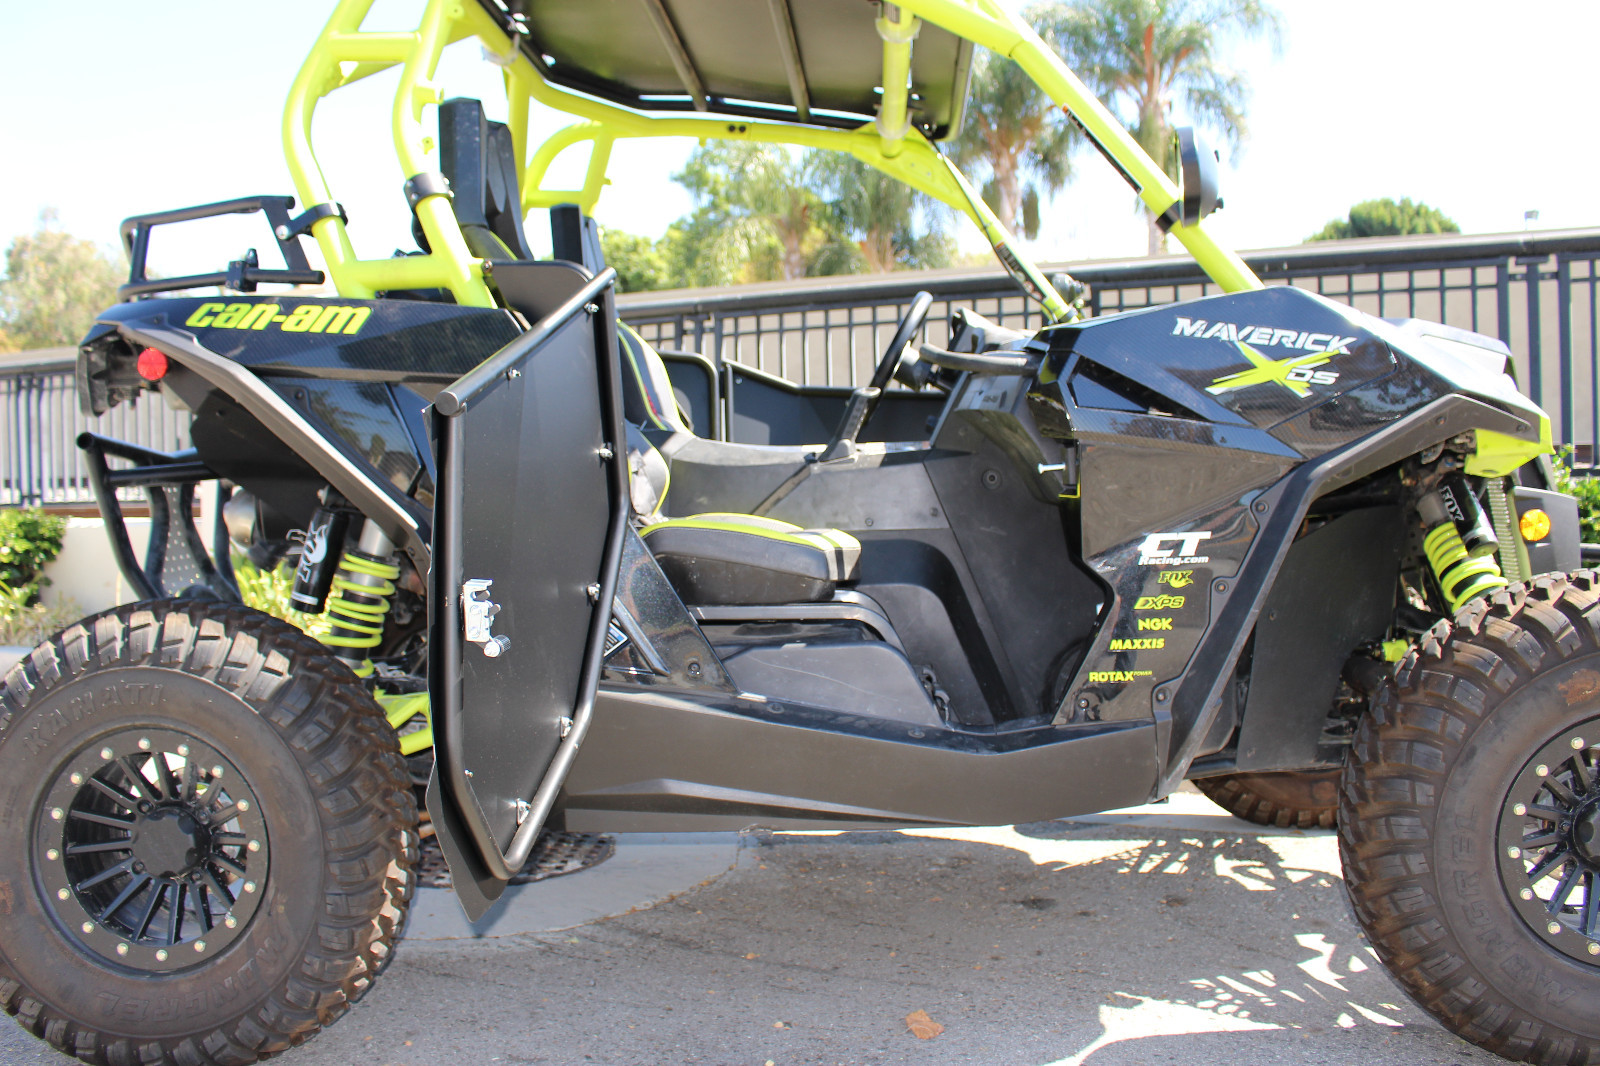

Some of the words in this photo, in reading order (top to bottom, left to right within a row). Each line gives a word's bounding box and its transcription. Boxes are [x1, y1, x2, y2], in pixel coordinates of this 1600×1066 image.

[185, 302, 372, 335] can-am
[1172, 317, 1357, 354] MAVERICK
[1286, 368, 1340, 385] DS
[1440, 485, 1465, 521] FOX
[1138, 531, 1212, 557] CT
[1138, 556, 1209, 566] Racing.com
[1157, 570, 1194, 588] FOX
[1137, 618, 1173, 631] NGK
[1109, 638, 1165, 650] MAXXIS
[1088, 671, 1134, 682] ROTAX
